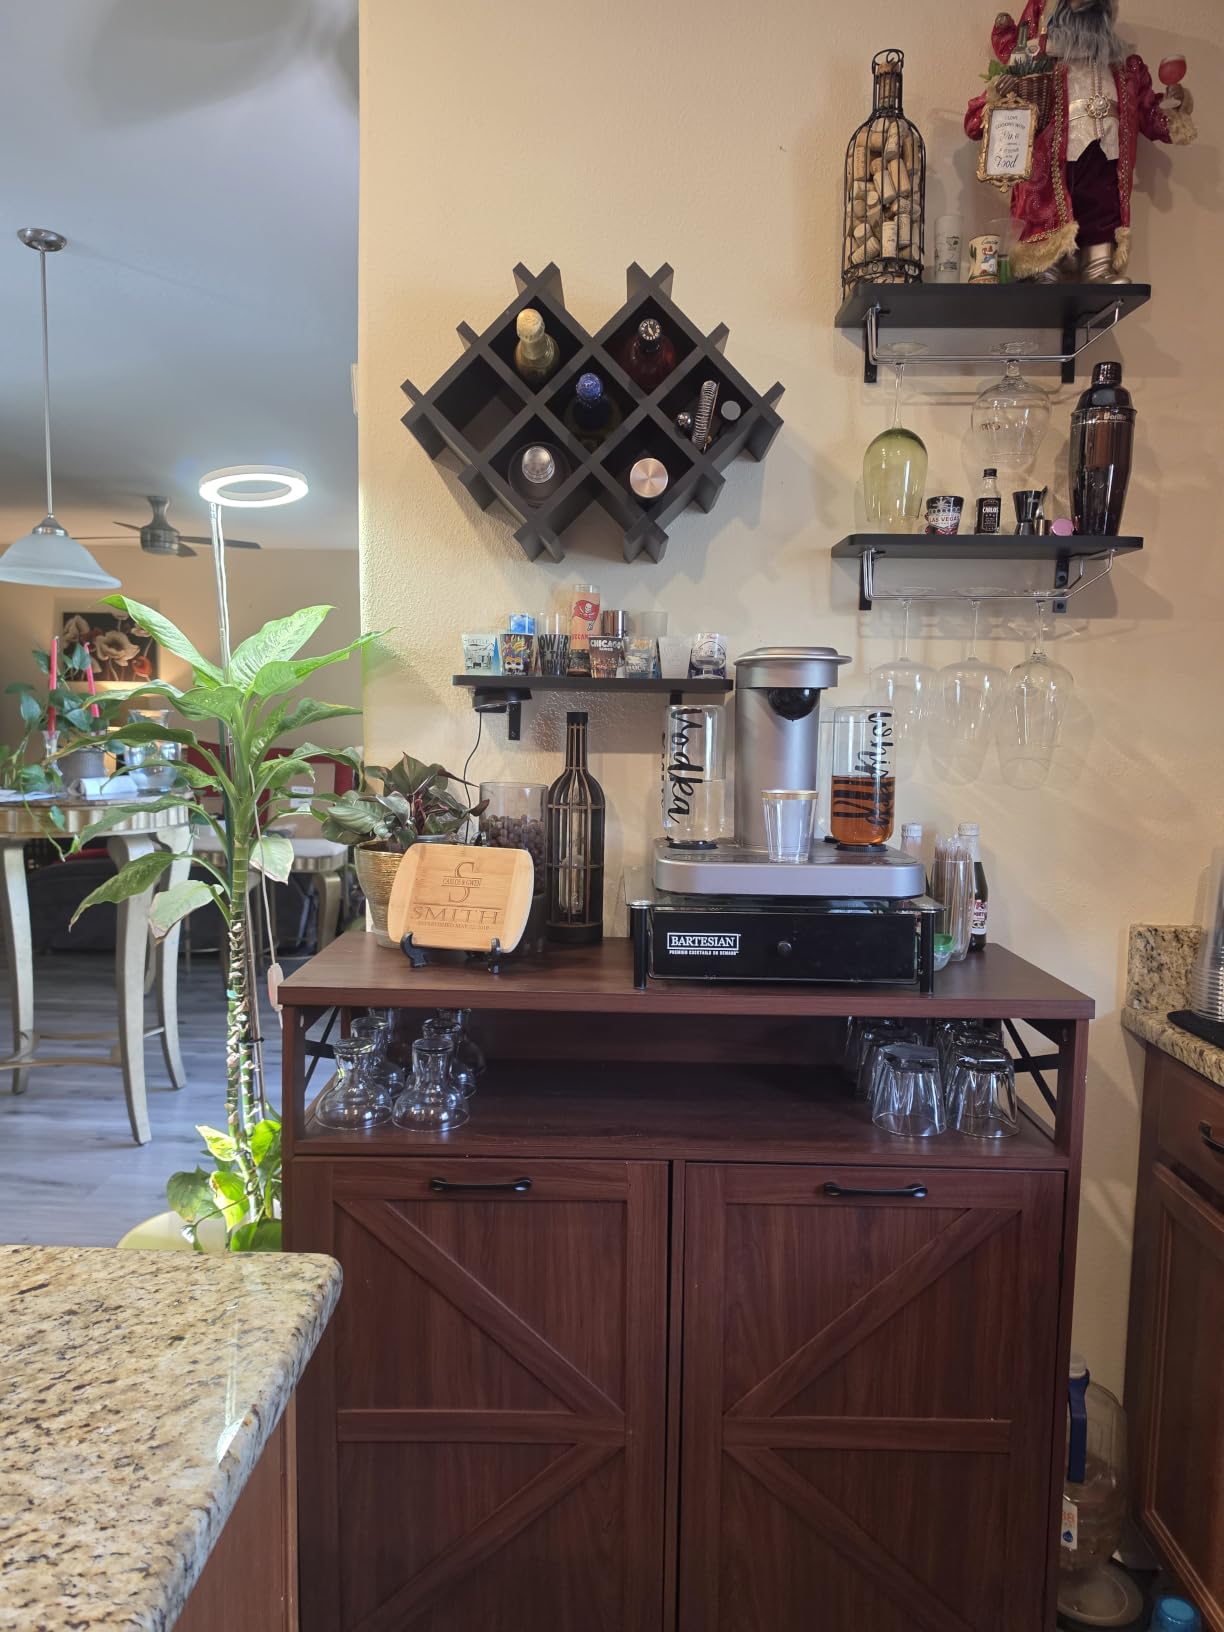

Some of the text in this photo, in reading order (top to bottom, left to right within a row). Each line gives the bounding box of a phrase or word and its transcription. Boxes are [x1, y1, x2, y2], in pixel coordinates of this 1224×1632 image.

[590, 639, 622, 650] CHICAGO
[667, 708, 704, 824] Vodka
[411, 905, 499, 925] SMITH
[671, 936, 736, 947] BARTESIAN
